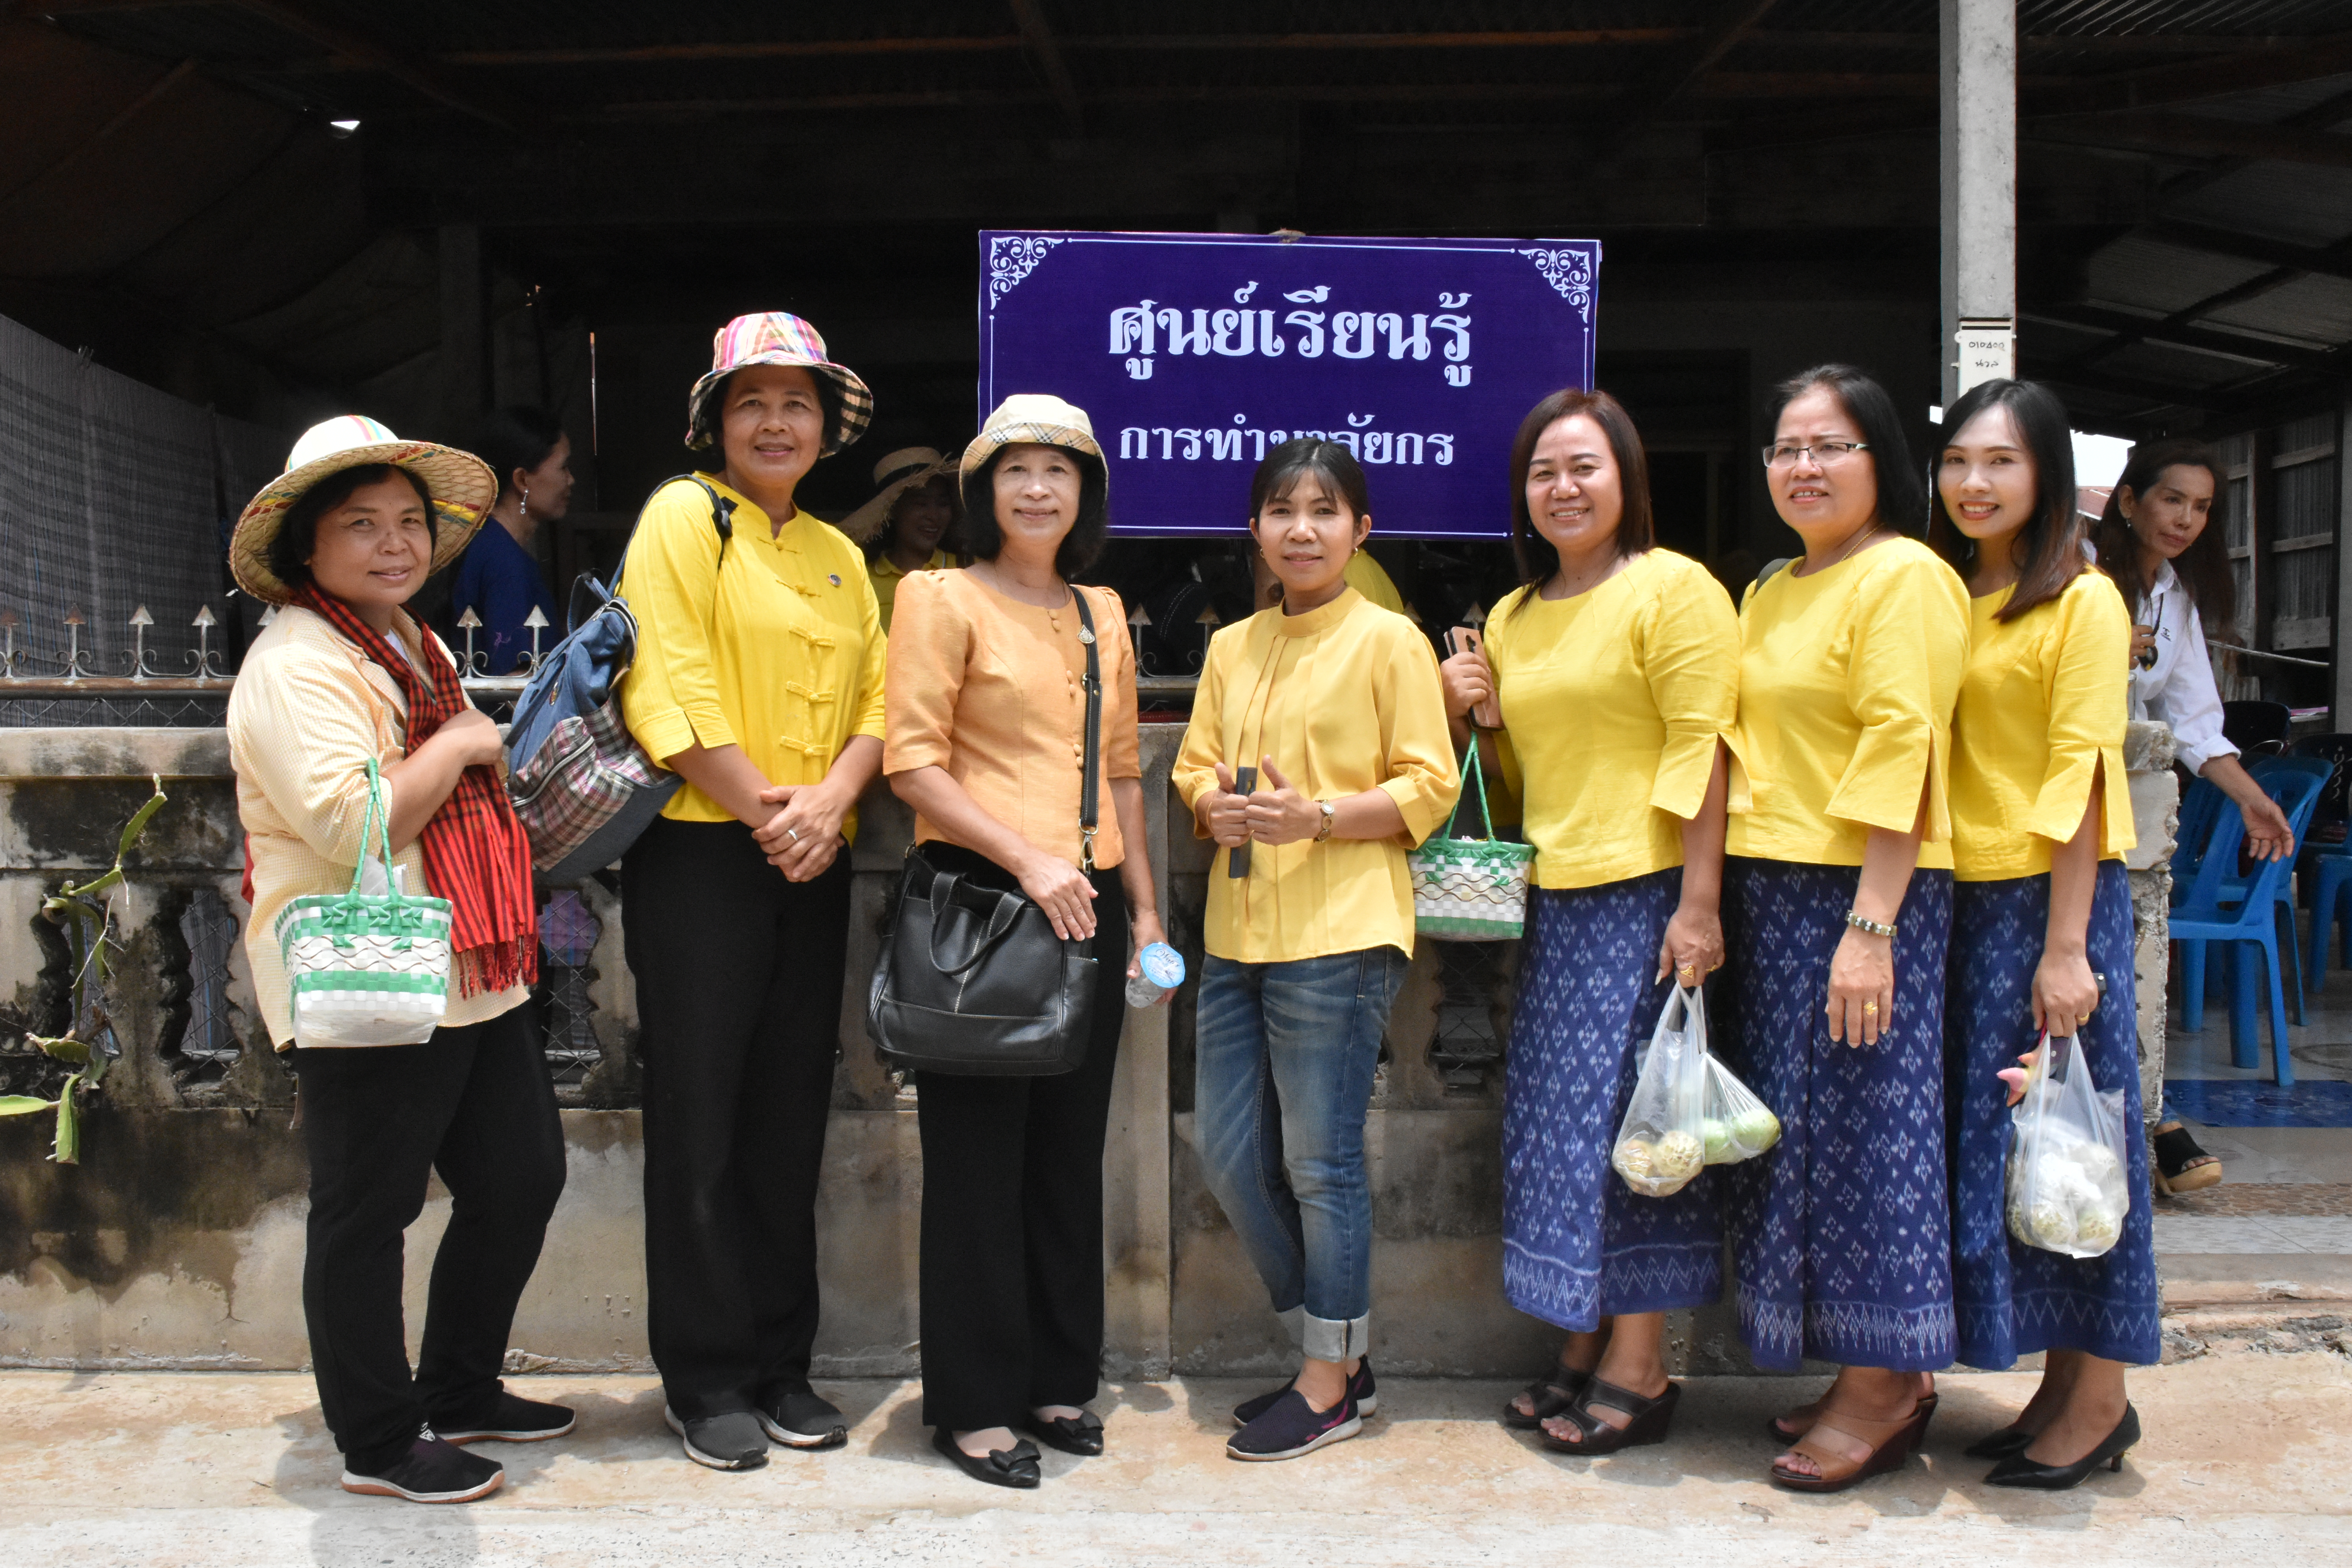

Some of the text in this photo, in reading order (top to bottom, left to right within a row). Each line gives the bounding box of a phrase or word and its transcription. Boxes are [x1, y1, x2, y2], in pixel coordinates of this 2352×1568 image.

[1109, 281, 1473, 387] ศูนย์เรียนรู้
